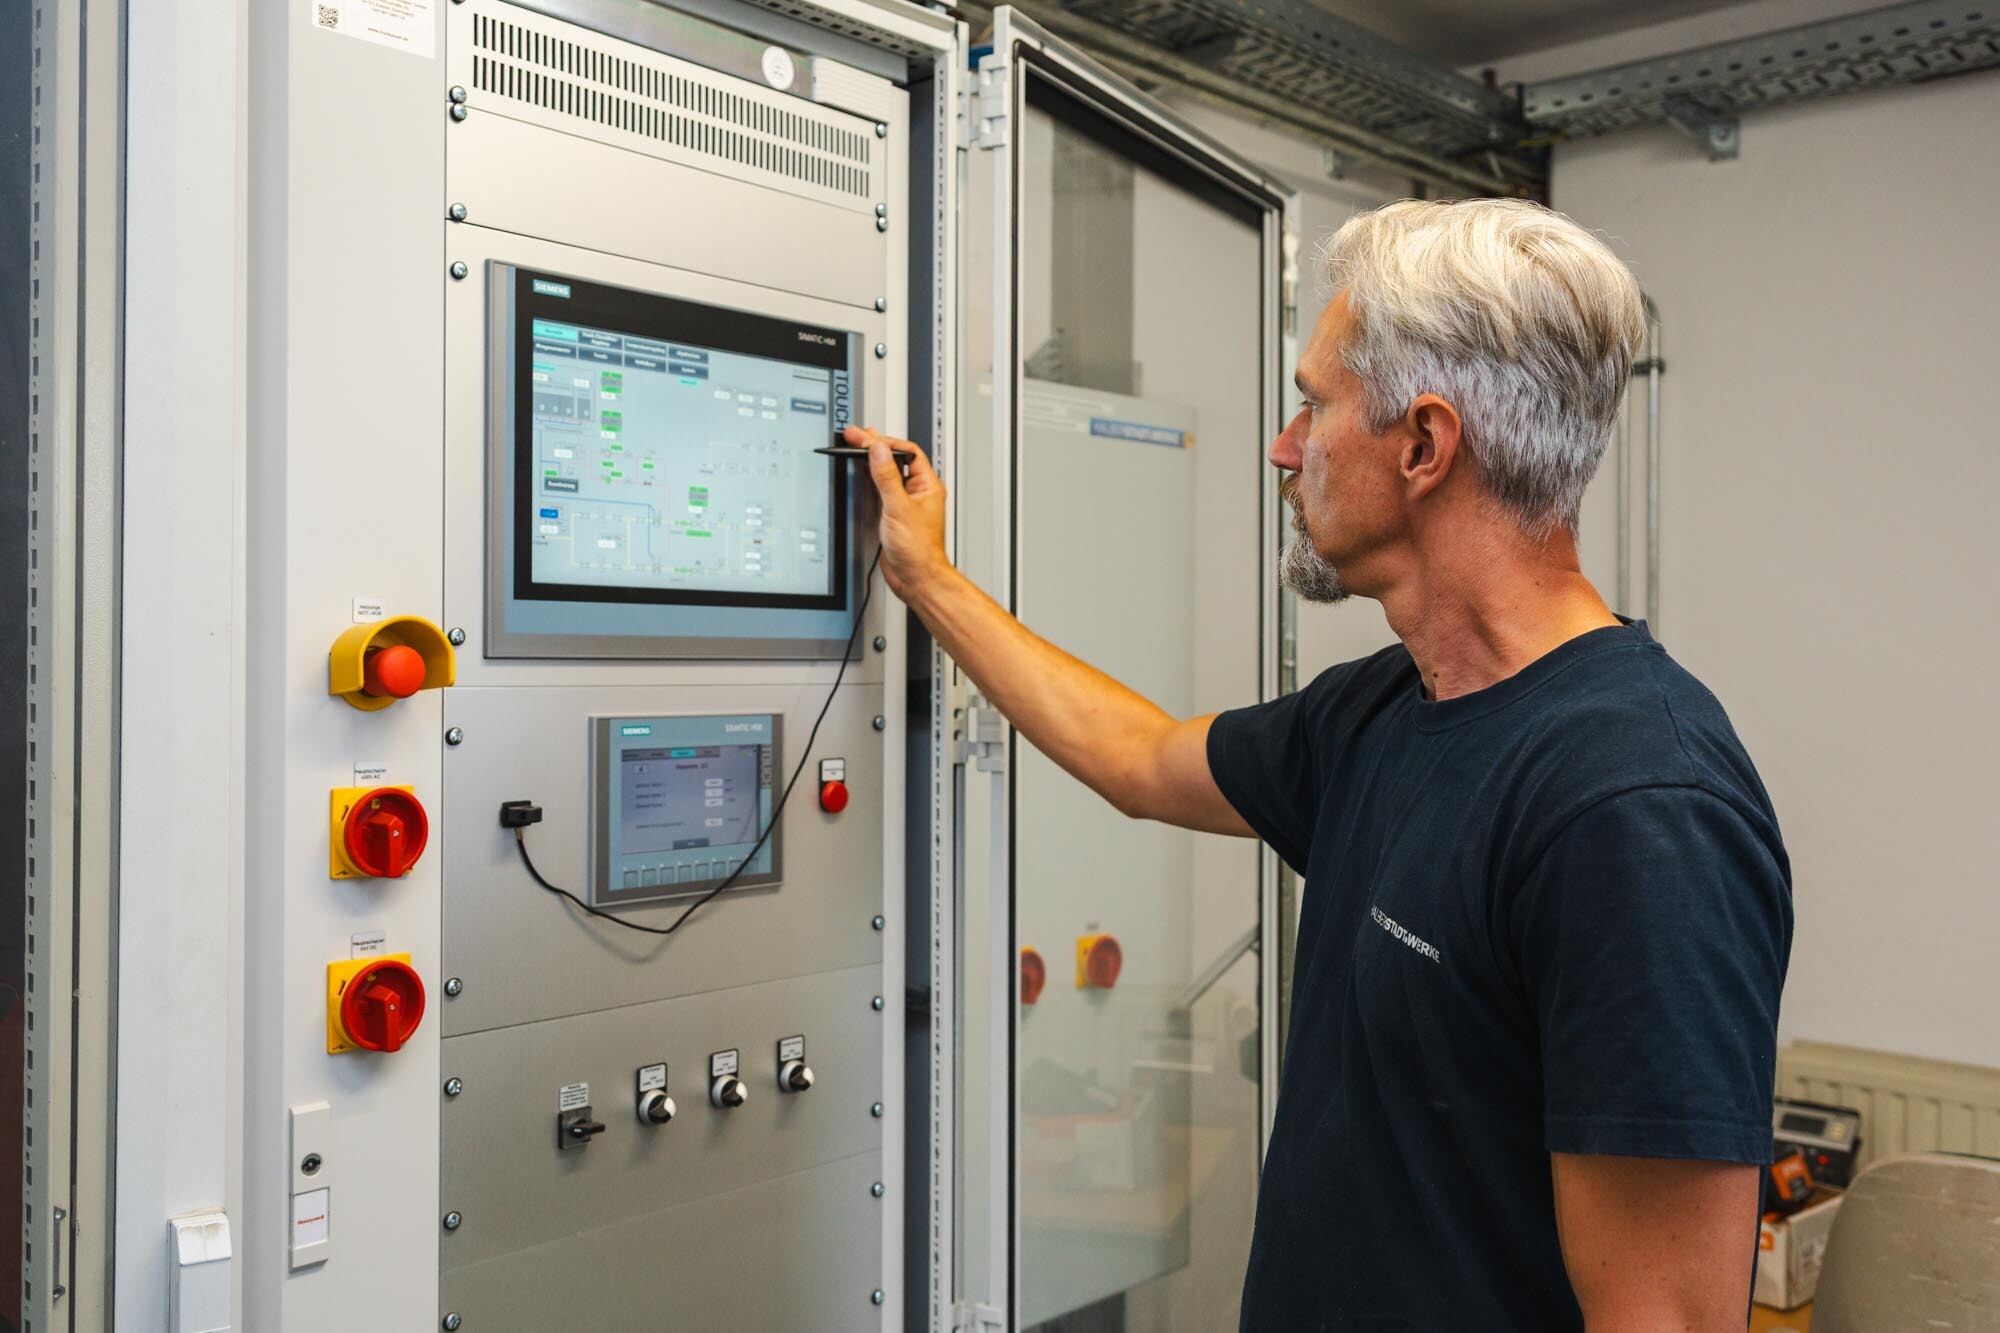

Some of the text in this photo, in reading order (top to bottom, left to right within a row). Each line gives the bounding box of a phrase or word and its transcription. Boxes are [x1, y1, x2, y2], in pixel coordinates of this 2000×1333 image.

[534, 282, 569, 296] SIEMENS
[798, 331, 837, 346] SIMATIC HMI
[836, 374, 849, 431] TOUCH
[622, 727, 651, 735] SIEMENS
[725, 723, 750, 733] SIMATIC
